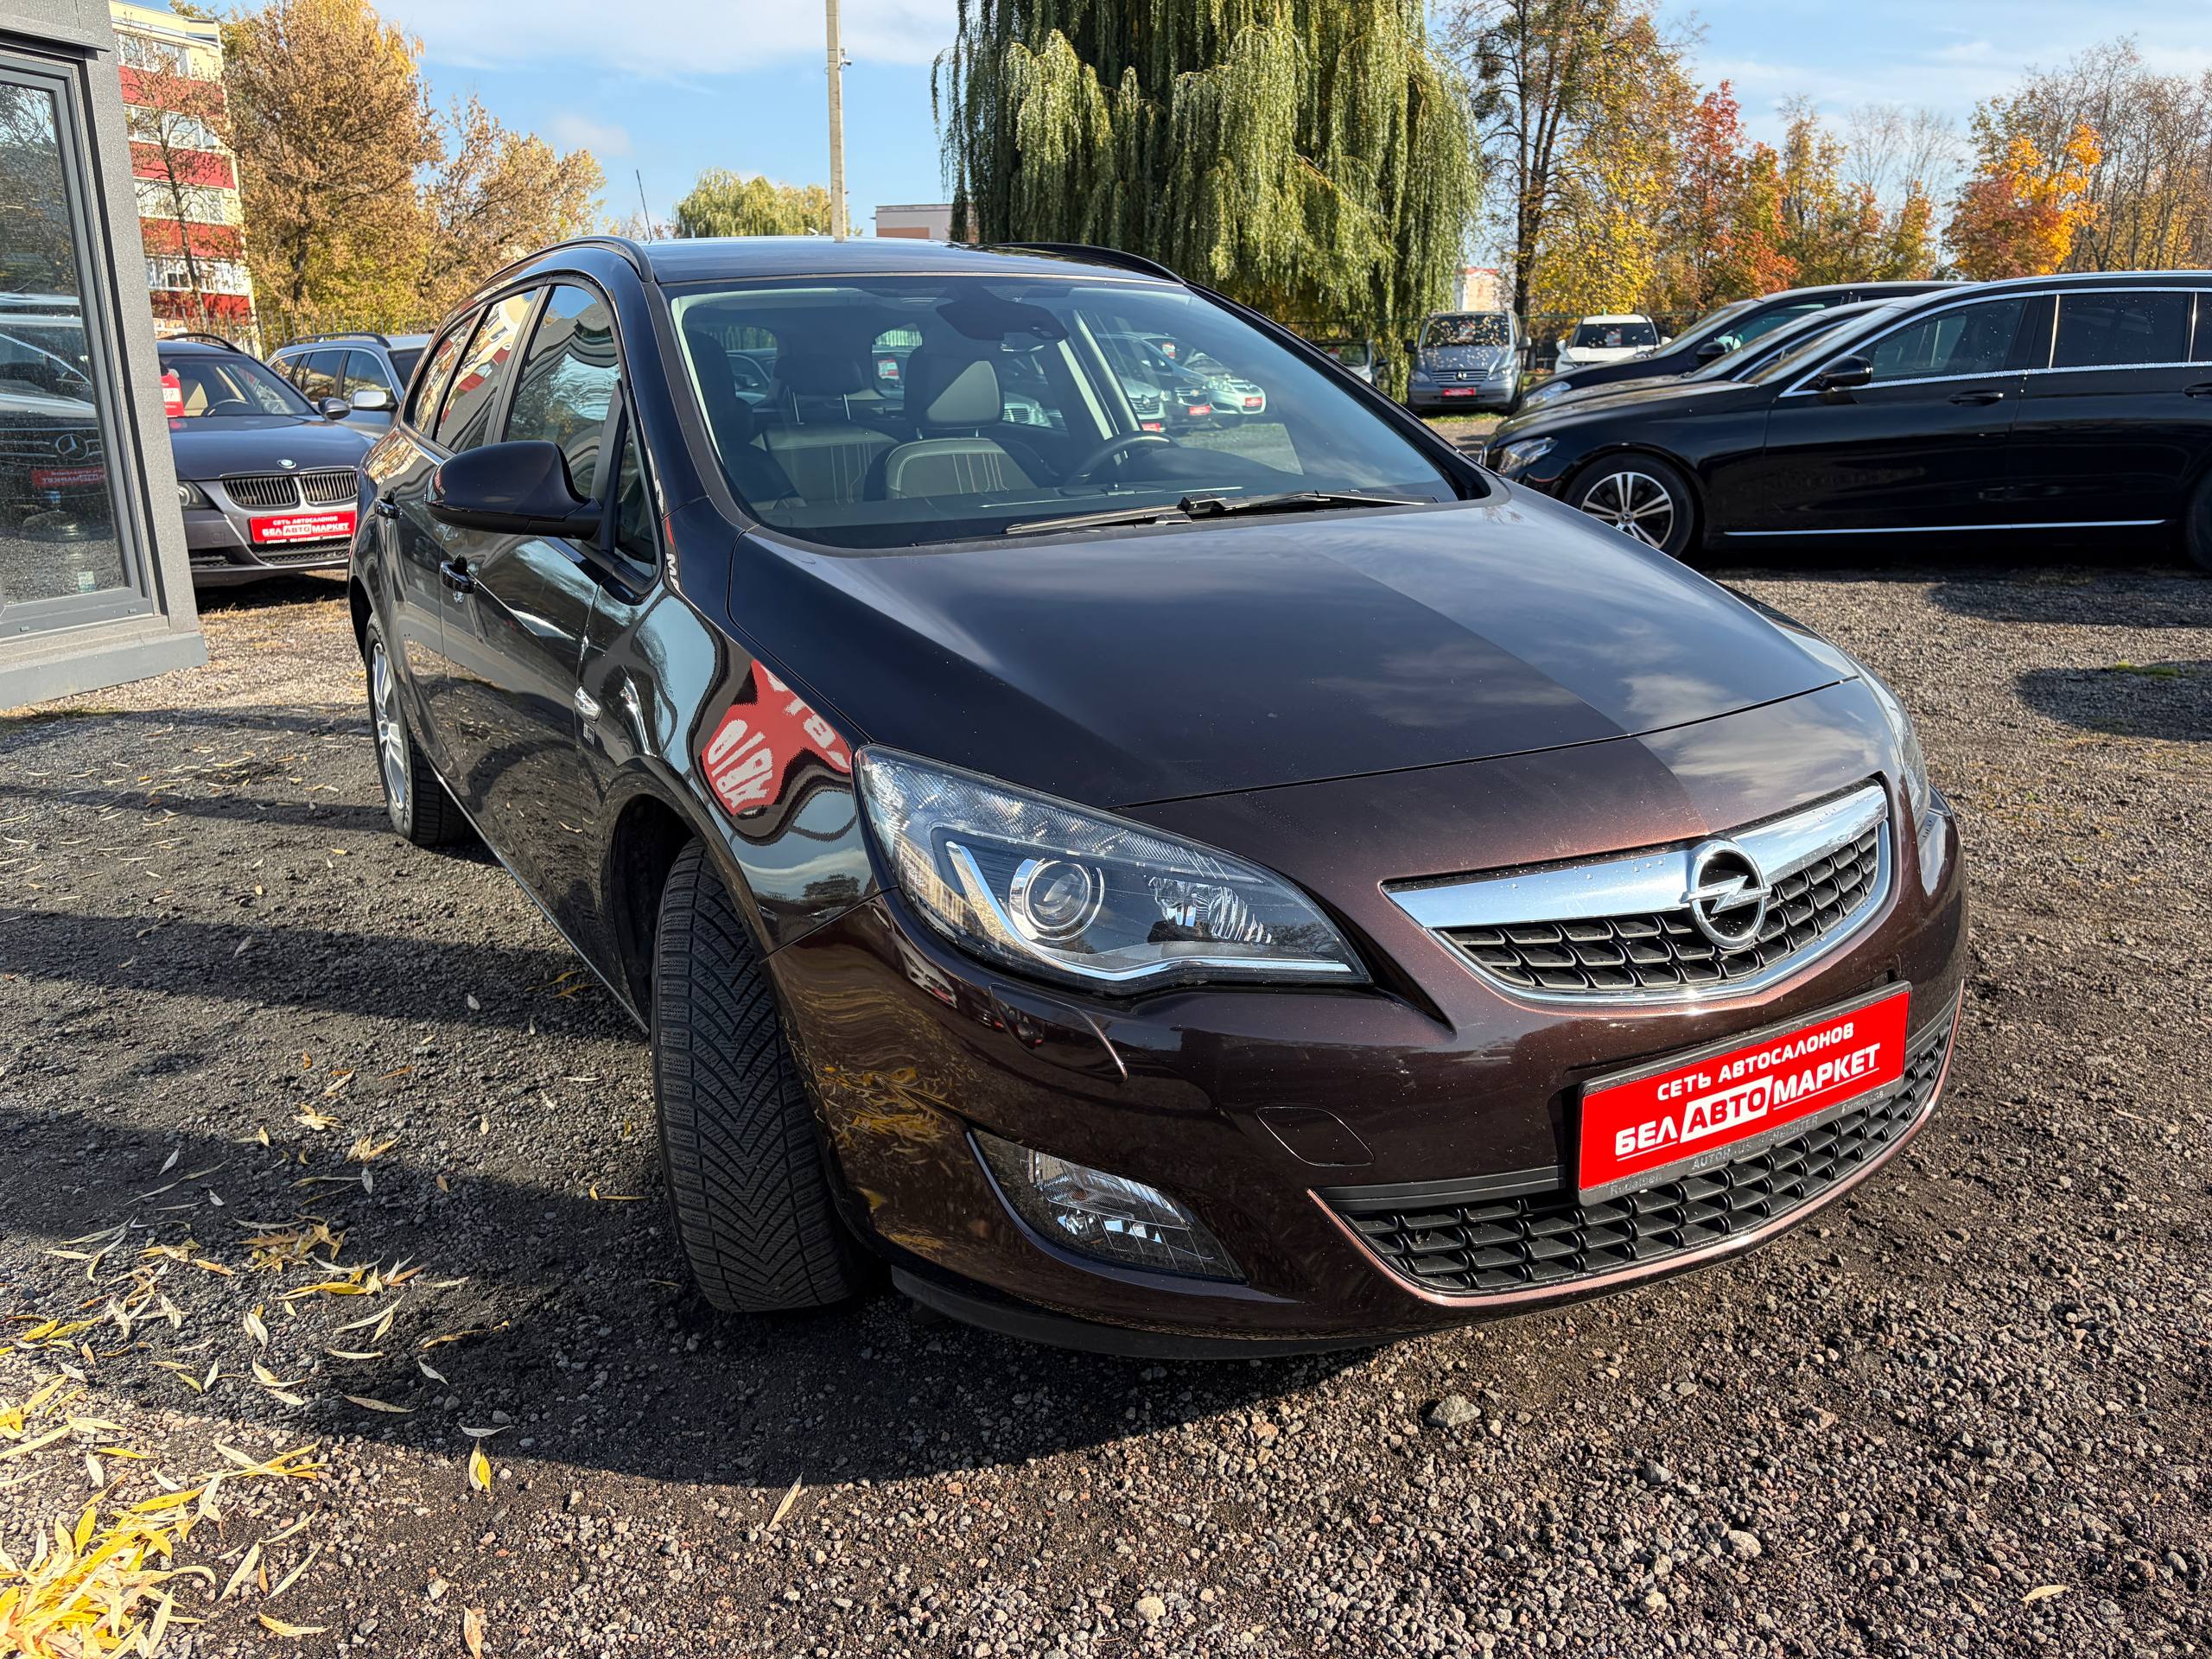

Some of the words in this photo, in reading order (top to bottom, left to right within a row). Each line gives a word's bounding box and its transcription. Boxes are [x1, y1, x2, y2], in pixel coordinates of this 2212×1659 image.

[292, 516, 339, 525] АВТОСАЛОНОВ
[1656, 1071, 1712, 1102] СЕТЬ
[1719, 1021, 1855, 1084] АВТОСАЛОНОВ
